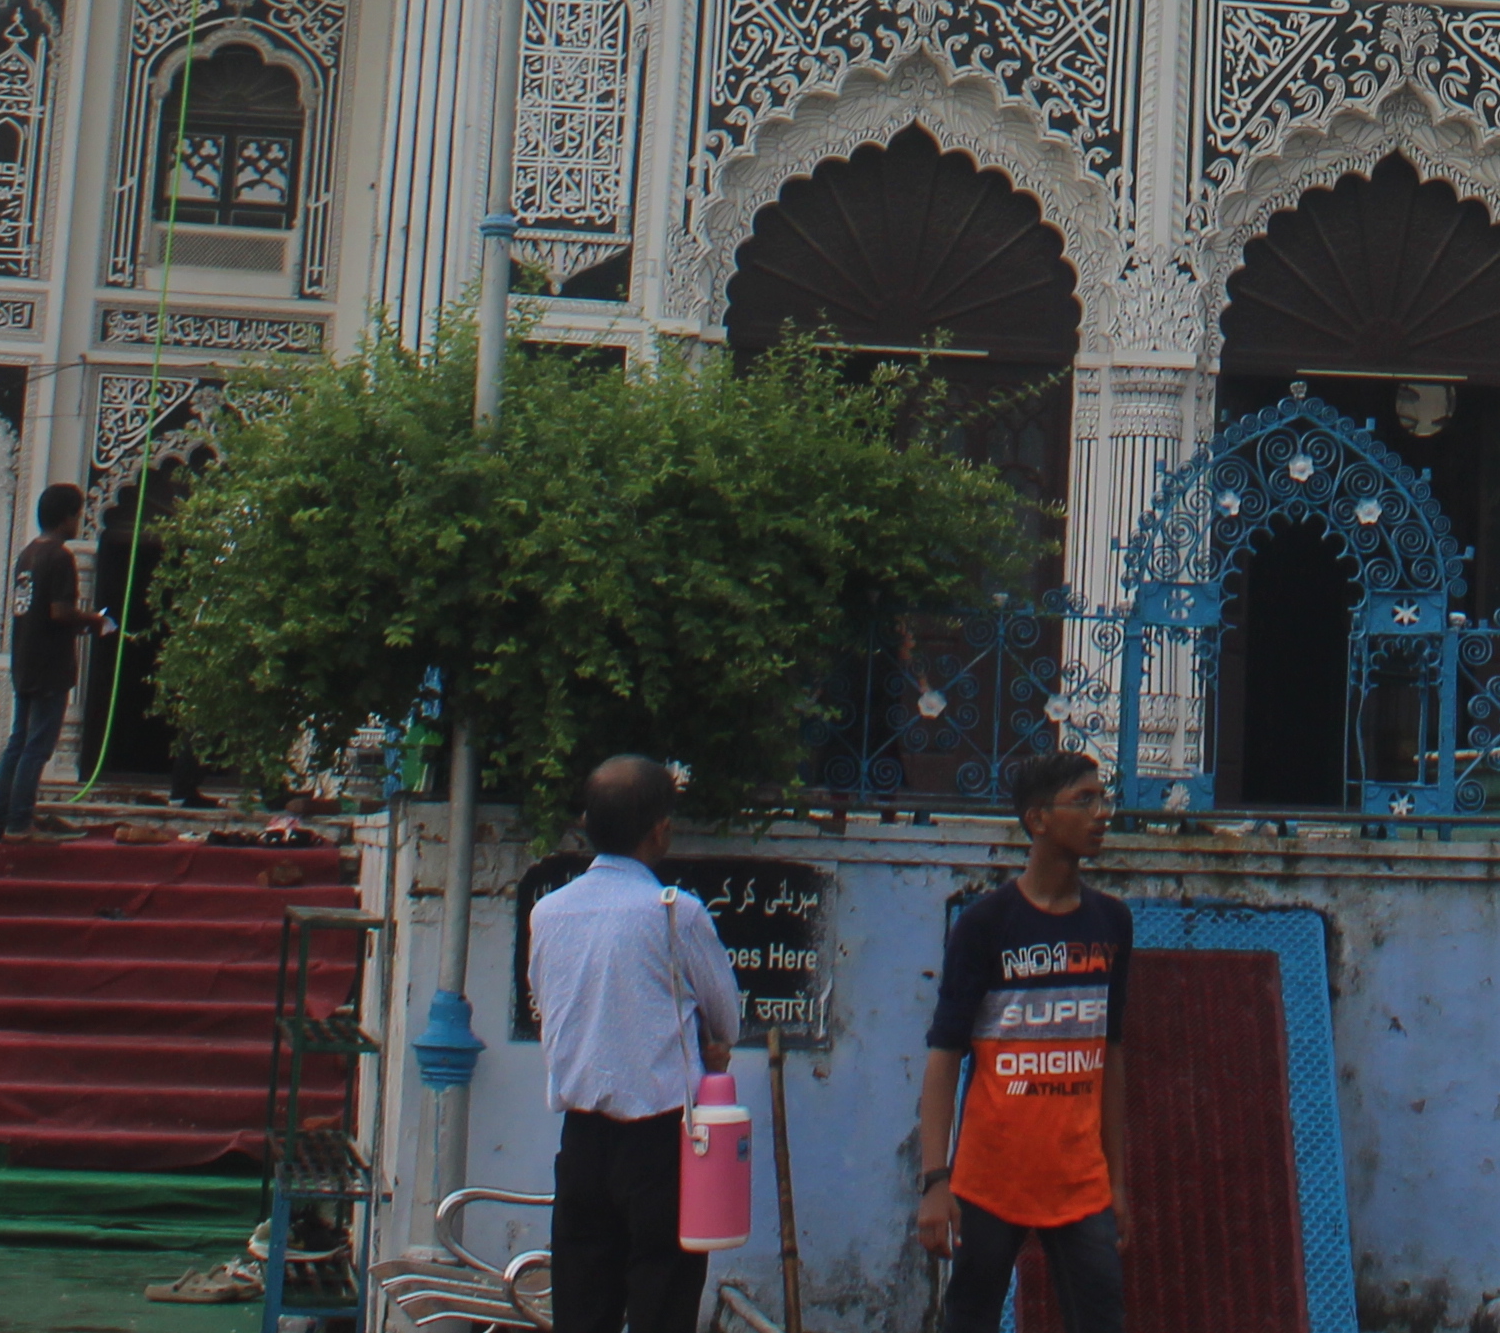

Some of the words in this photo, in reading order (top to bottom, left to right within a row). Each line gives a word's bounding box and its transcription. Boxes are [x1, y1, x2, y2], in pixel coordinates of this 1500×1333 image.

[725, 946, 762, 969] oes
[768, 942, 819, 970] Here
[995, 1047, 1104, 1076] ORIGINL
